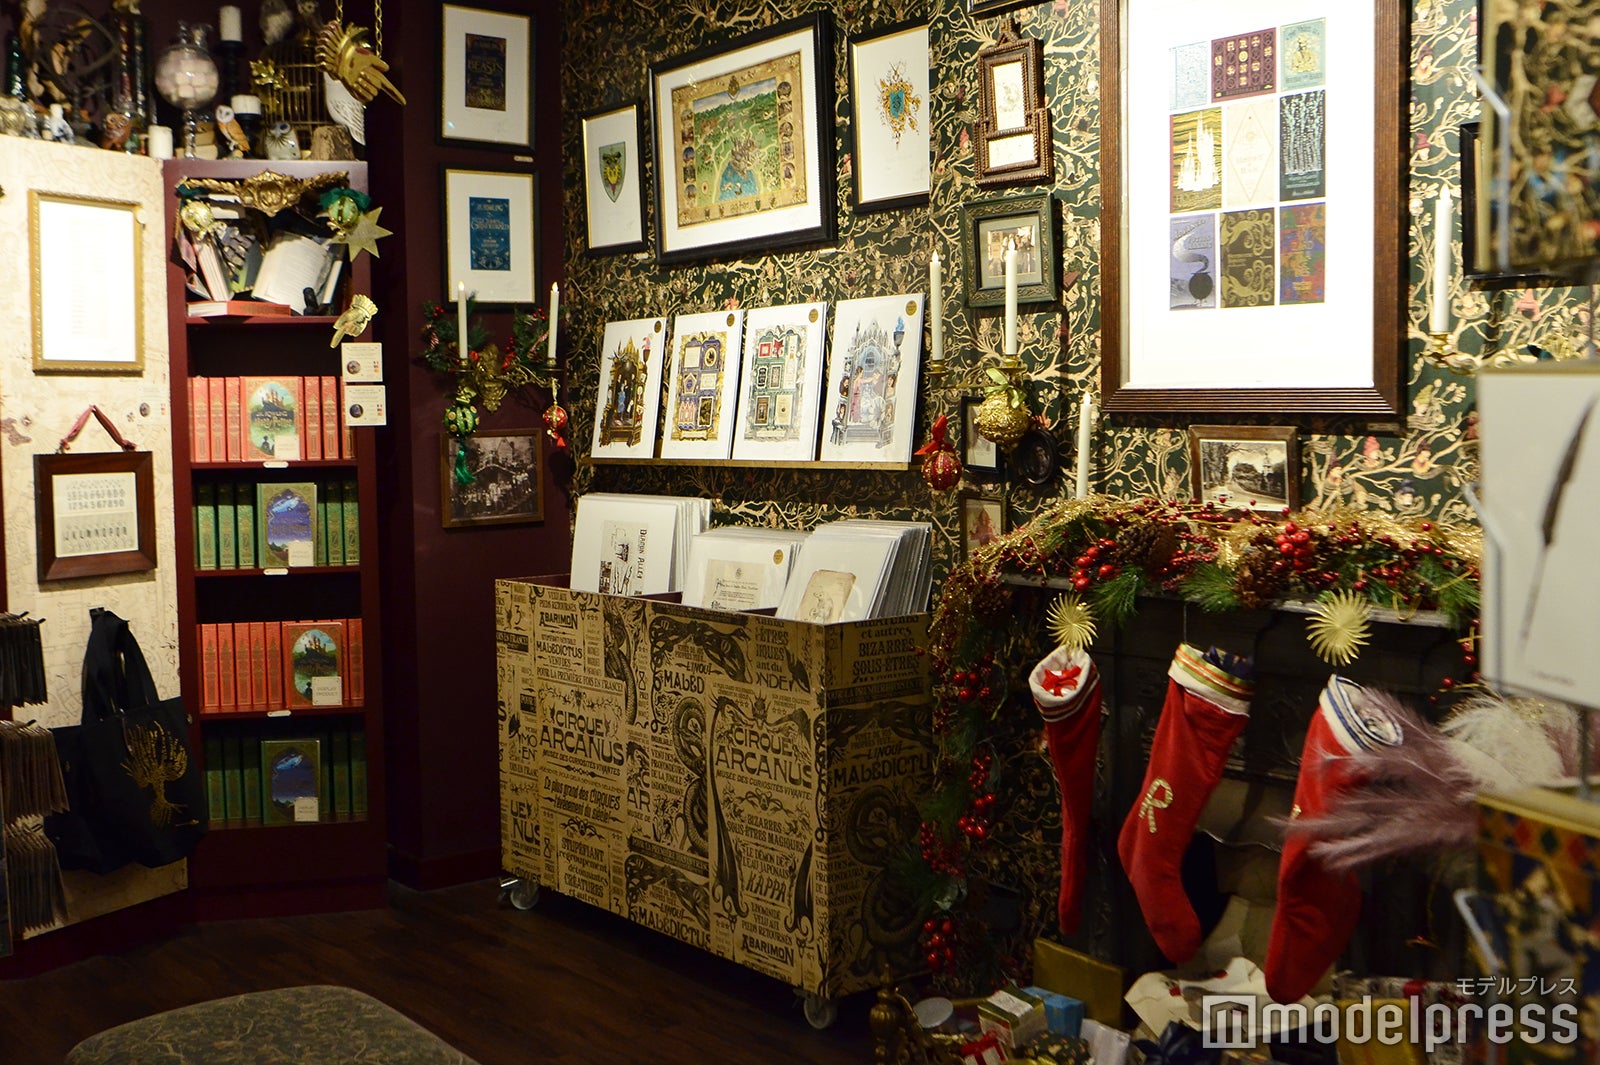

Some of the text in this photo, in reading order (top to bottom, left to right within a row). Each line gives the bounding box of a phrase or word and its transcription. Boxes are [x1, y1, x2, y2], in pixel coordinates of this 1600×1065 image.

[540, 611, 578, 629] ABARIMON
[875, 627, 912, 639] autres
[859, 638, 916, 657] BIZARRES
[556, 710, 605, 737] CIRQUE
[540, 725, 624, 766] ARCANUS
[734, 727, 793, 757] CIRQUE
[715, 745, 812, 789] ARCANUS
[737, 774, 749, 785] DES
[1138, 776, 1174, 833] R
[768, 832, 805, 854] MAGIQUES
[746, 871, 787, 902] KAPPA
[741, 933, 794, 967] ABARIMON
